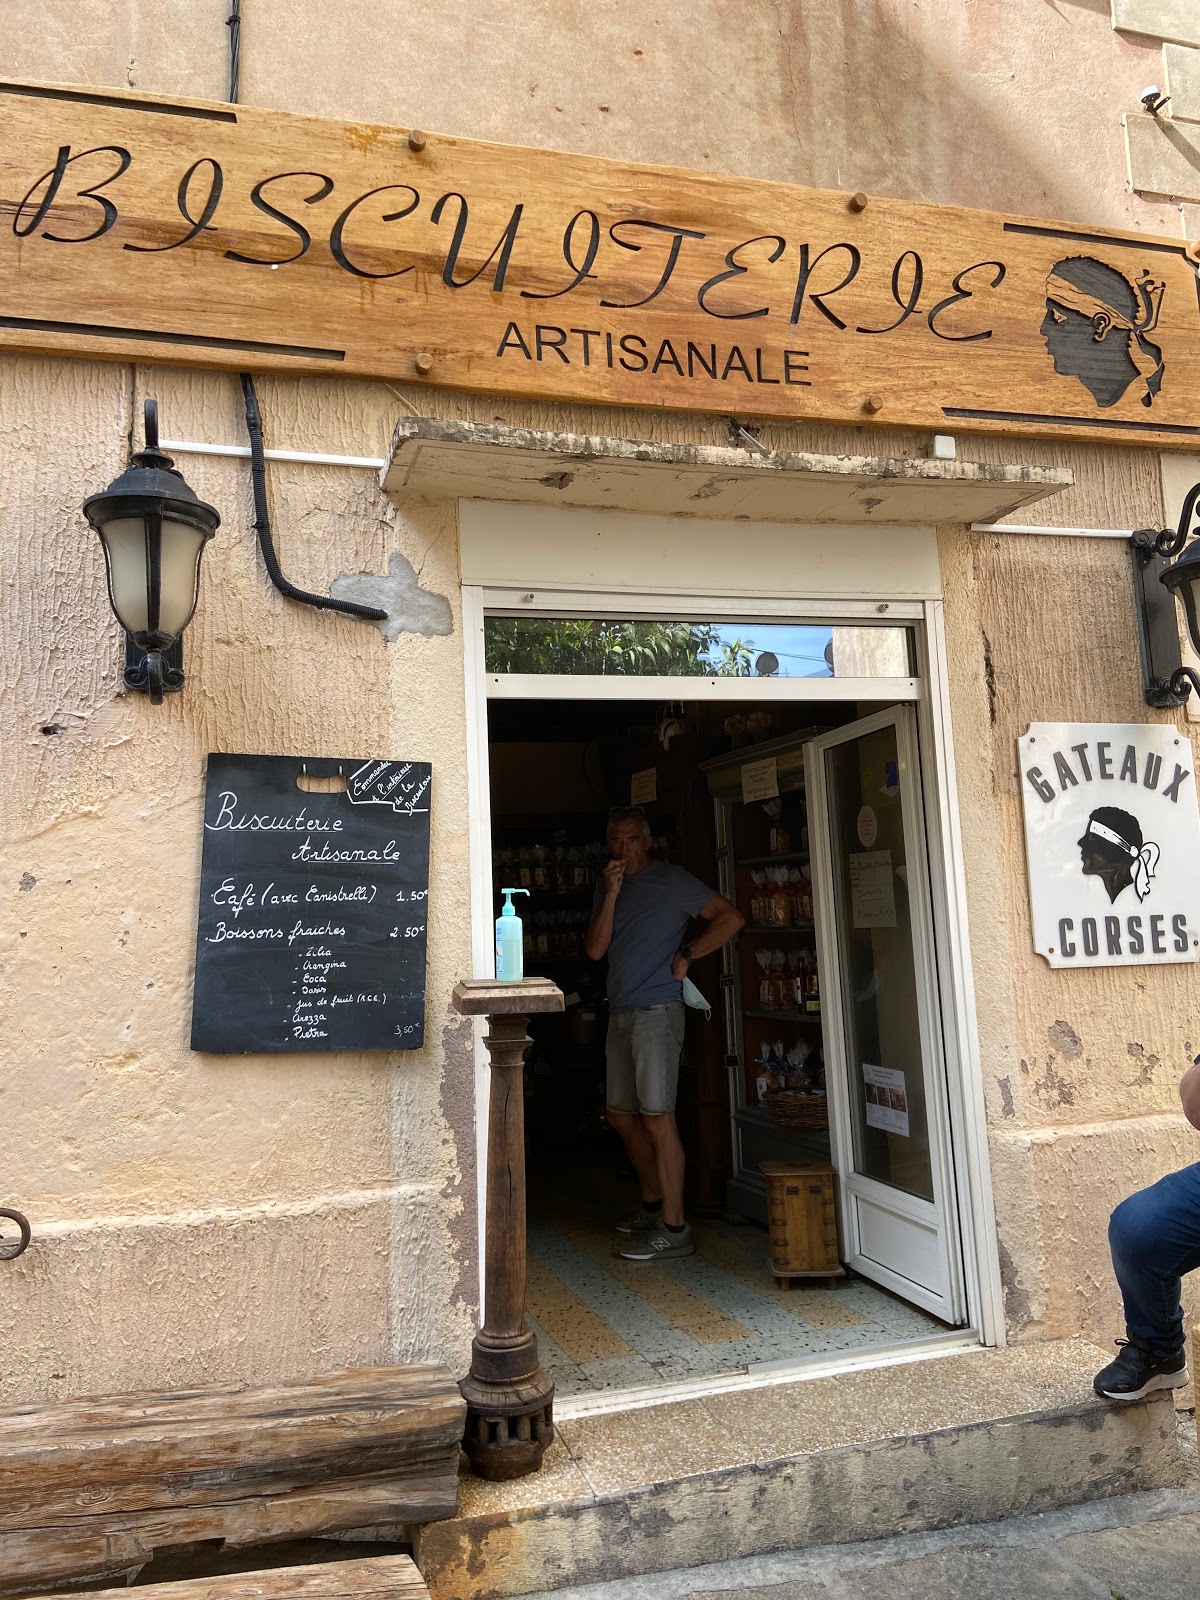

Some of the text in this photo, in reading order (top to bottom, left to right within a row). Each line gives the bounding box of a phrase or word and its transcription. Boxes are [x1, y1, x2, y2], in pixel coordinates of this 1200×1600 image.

[12, 145, 1006, 341] BISCUITERIE
[496, 321, 812, 386] ARTISANALE
[1026, 742, 1190, 803] GATEAUX
[204, 791, 344, 831] Biscuiterie
[394, 796, 405, 806] de
[292, 836, 401, 861] Artisanale
[212, 878, 256, 918] Café
[261, 883, 299, 906] (avec
[208, 921, 284, 943] Boissons
[1058, 914, 1189, 957] CORSES
[302, 959, 347, 974] Orangina
[302, 972, 327, 983] Coca
[301, 984, 327, 994] Oasis
[316, 997, 328, 1006] de
[330, 993, 354, 1008] fruit
[292, 1026, 329, 1039] Pietra
